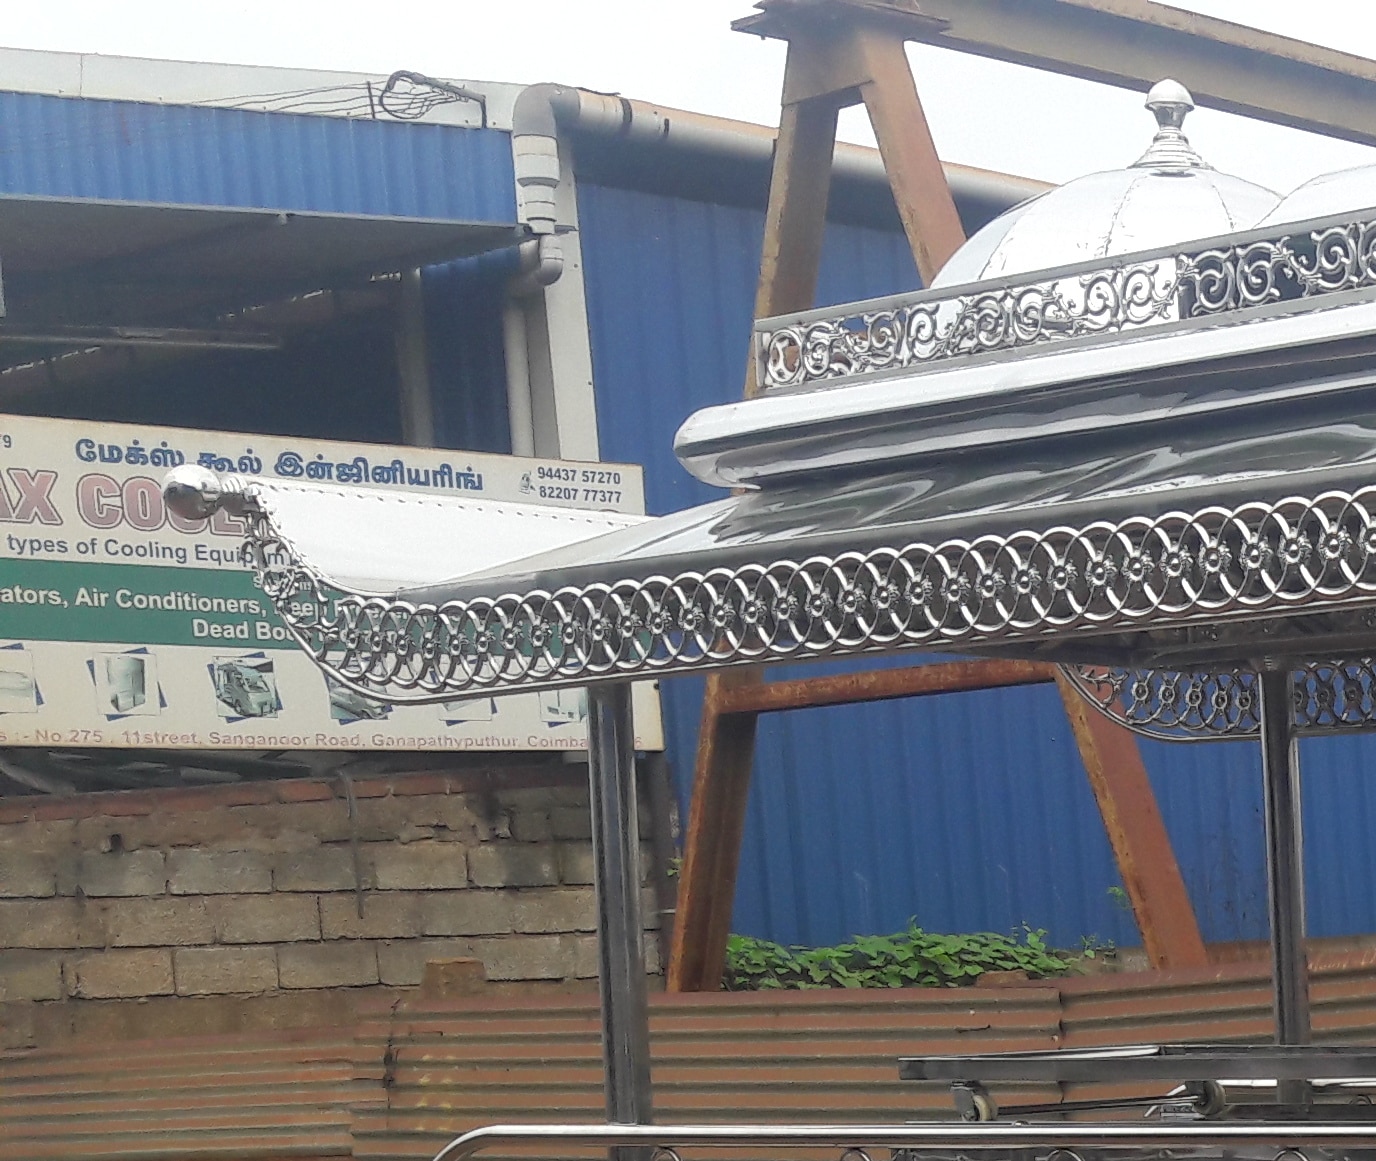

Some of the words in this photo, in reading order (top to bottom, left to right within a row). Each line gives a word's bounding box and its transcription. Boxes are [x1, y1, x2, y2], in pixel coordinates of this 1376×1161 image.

[75, 438, 185, 468] மேக்ஸ்
[537, 466, 577, 482] 94437
[581, 470, 621, 485] 57270
[539, 485, 578, 501] 82207
[583, 488, 622, 503] 77377
[7, 533, 68, 556] types
[76, 537, 99, 556] of
[104, 539, 188, 564] Cooling
[0, 584, 69, 609] ators,
[74, 586, 110, 607] Air
[116, 589, 267, 618] Conditioners,
[192, 619, 250, 640] Dead
